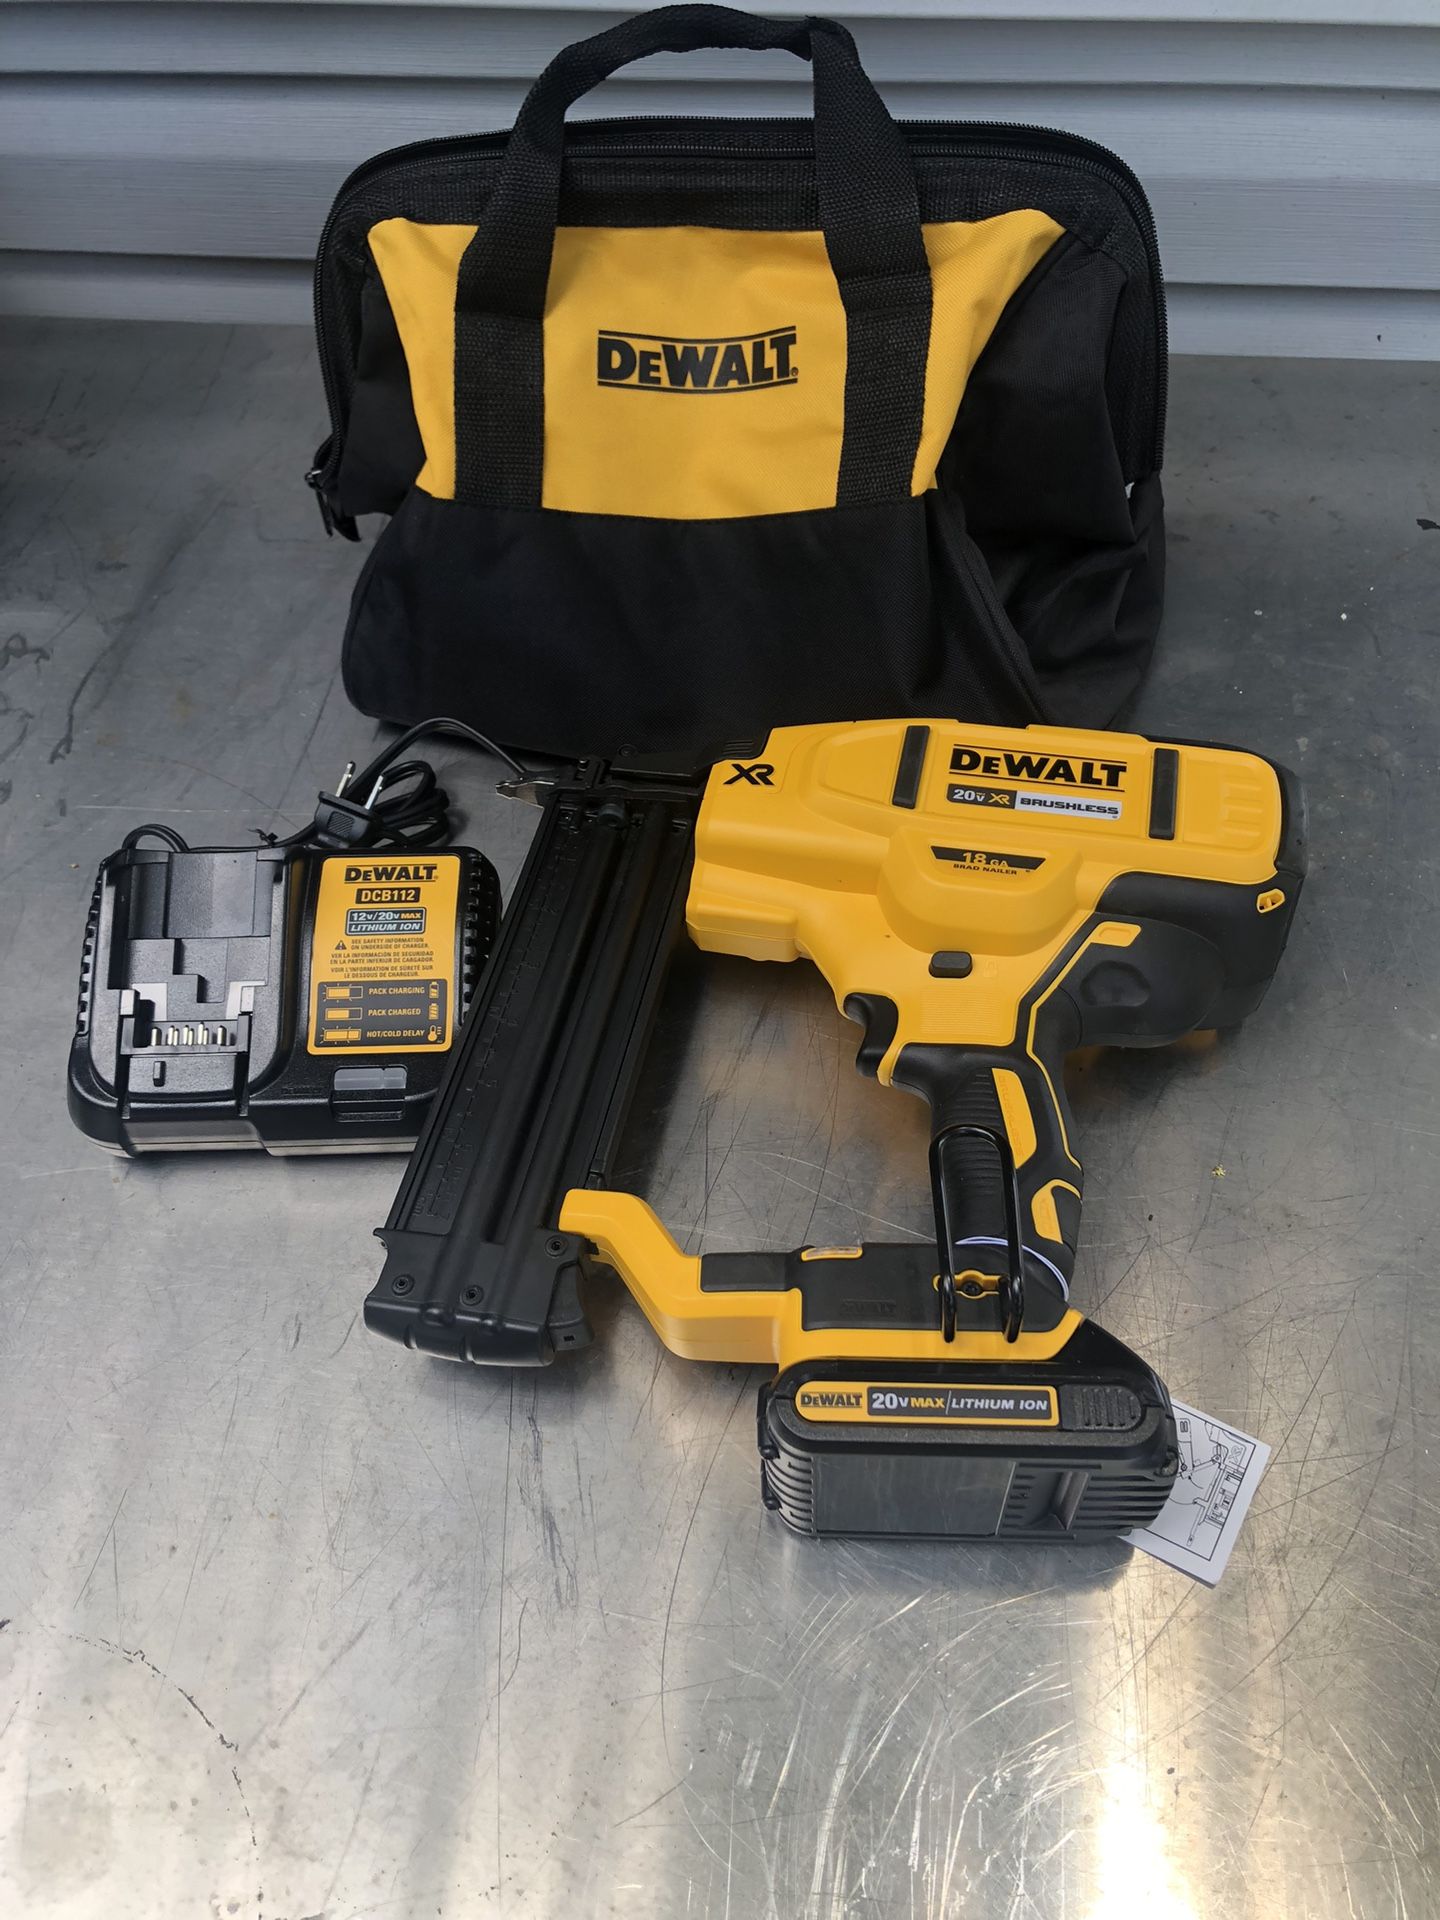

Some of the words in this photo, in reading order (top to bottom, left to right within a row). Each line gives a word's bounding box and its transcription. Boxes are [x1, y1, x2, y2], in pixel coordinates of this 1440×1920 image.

[597, 332, 797, 388] DEWALT
[949, 747, 1128, 788] DEWALT
[723, 763, 775, 786] XR
[988, 792, 1011, 805] XR
[1020, 797, 1119, 815] BRUSHLESS
[963, 851, 987, 865] 18
[989, 859, 1009, 868] GA
[344, 866, 437, 882] DEWALT
[953, 863, 980, 871] BRAD
[982, 867, 1017, 875] NAILER
[360, 889, 416, 902] DCB112
[400, 912, 422, 920] MAX
[350, 923, 397, 932] LITHIUM
[399, 922, 421, 931] ION
[388, 986, 425, 994] CHARGING
[387, 1008, 421, 1016] CHARGED
[366, 1029, 401, 1038] HOT/COLD
[402, 1029, 425, 1037] DELAY
[800, 1392, 862, 1408] DEWALT
[910, 1398, 945, 1408] MAX
[951, 1398, 1014, 1410] LITHIUM
[1019, 1399, 1048, 1410] ION
